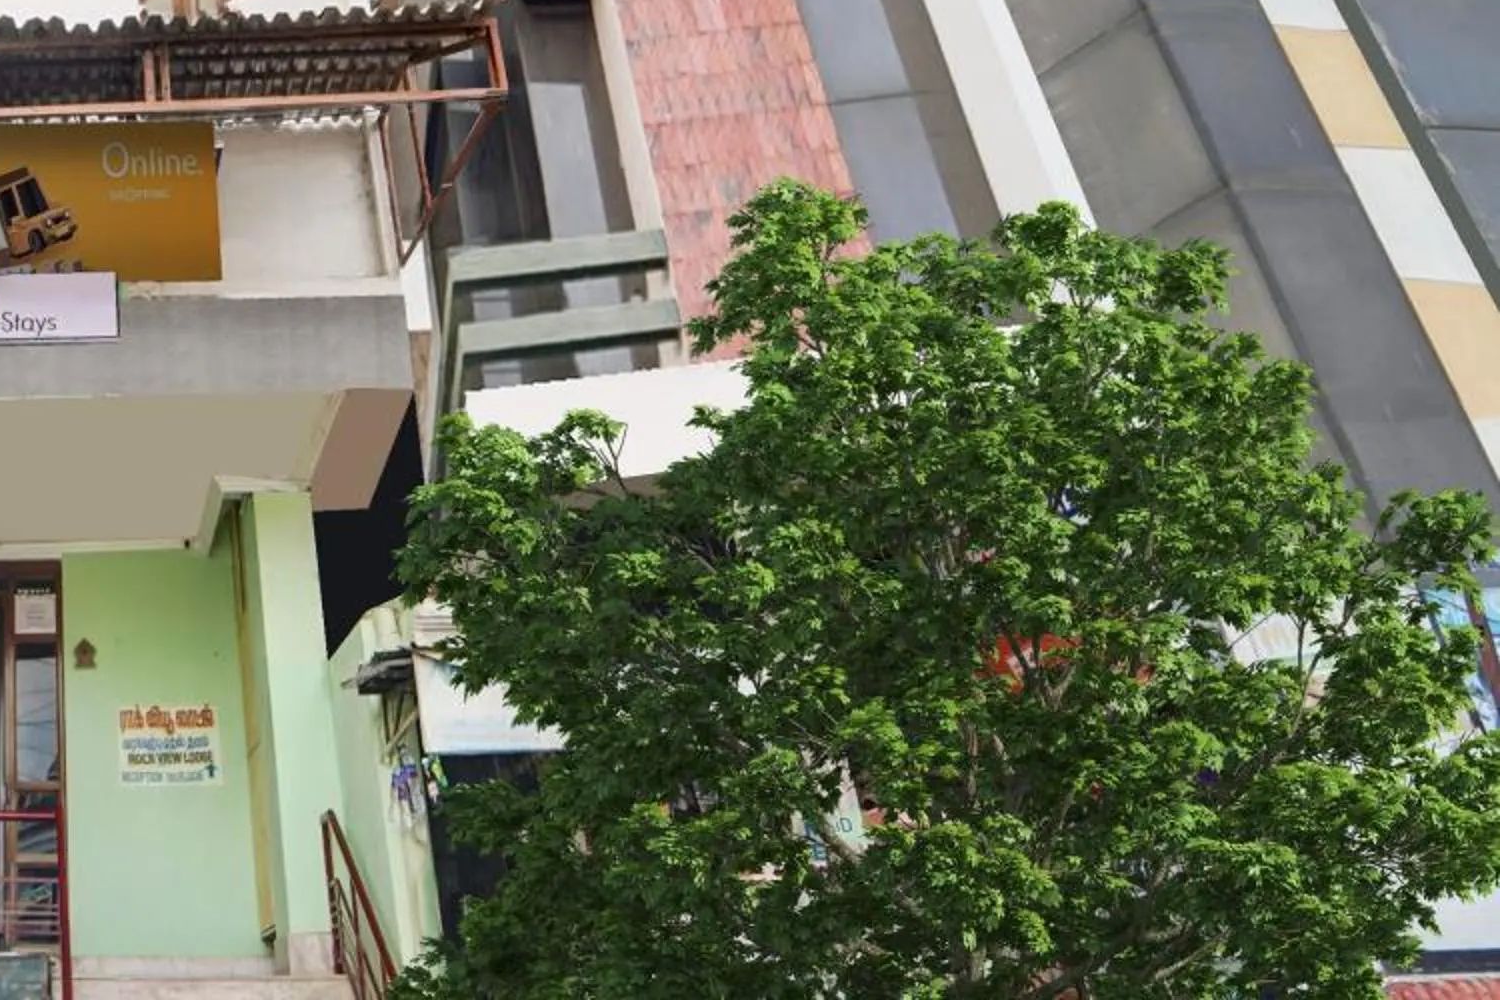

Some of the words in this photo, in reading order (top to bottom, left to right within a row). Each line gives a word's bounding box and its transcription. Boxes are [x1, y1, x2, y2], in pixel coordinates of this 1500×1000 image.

[1, 311, 57, 337] Stays
[128, 752, 154, 765] ROCK
[157, 752, 182, 764] VIEW
